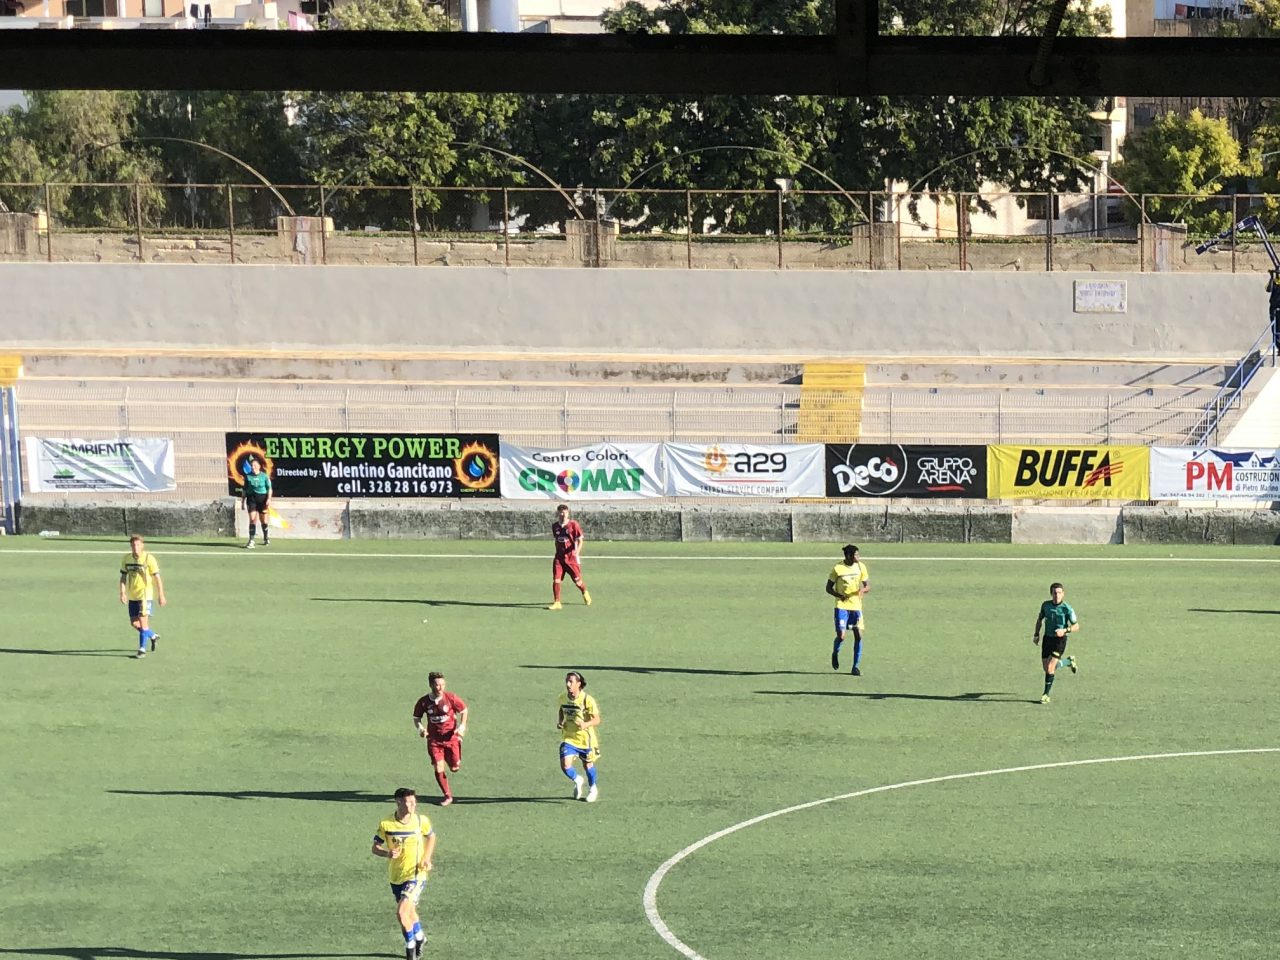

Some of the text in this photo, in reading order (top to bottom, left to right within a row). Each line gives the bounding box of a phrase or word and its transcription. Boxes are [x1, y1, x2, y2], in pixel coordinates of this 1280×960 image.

[264, 437, 462, 459] ENERGY POWER
[532, 449, 629, 463] Centro Colori
[734, 452, 787, 473] a29
[322, 462, 452, 478] Valentino Gancitano
[917, 457, 973, 470] GRUPPO
[1014, 449, 1112, 487] BUFFA
[276, 467, 308, 477] Directed
[917, 470, 972, 484] ARENA
[1186, 462, 1233, 491] PM
[337, 480, 453, 493] cell. 328 28 16 973
[518, 467, 645, 493] CROMAT
[757, 486, 788, 494] COMPANY
[1235, 483, 1279, 492] di Pietro Marino
